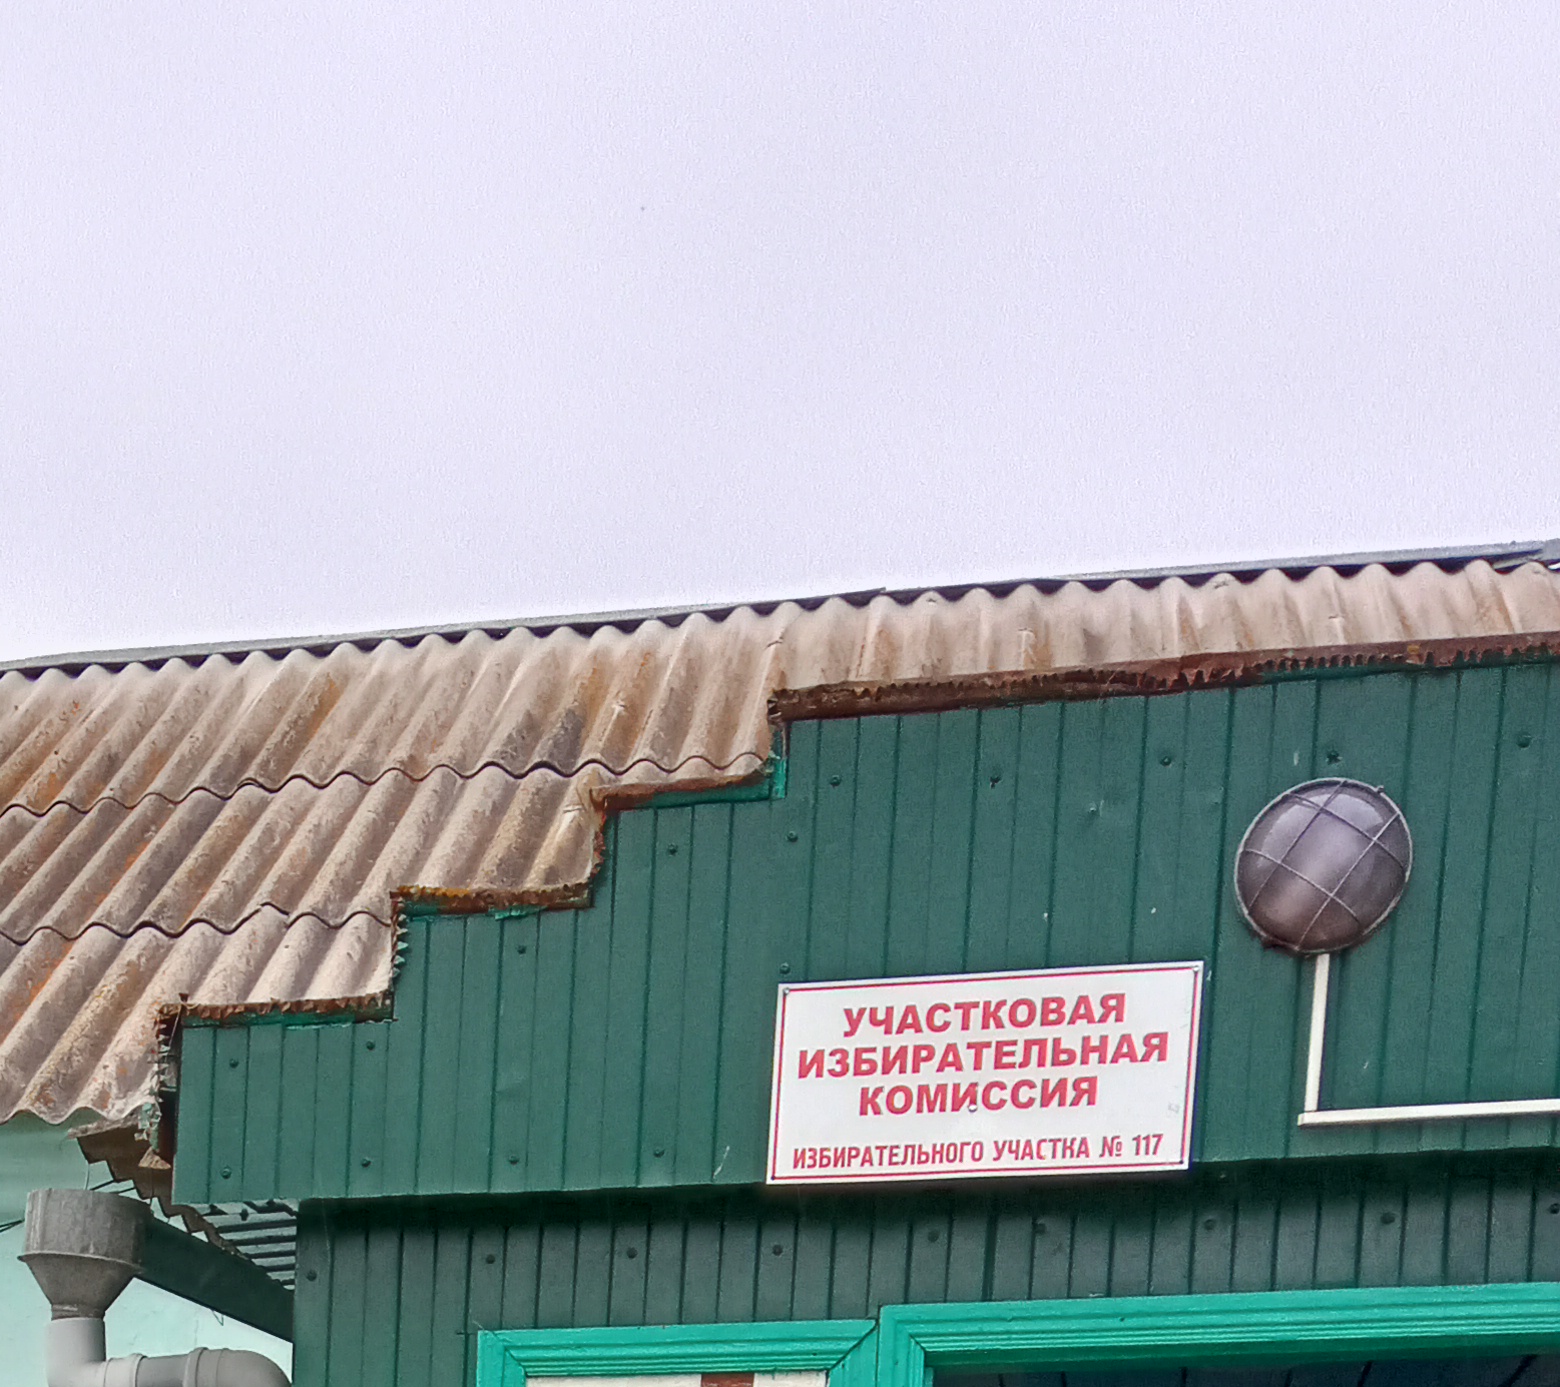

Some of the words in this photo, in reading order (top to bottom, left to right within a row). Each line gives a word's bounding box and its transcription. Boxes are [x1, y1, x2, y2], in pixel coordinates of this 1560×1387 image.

[843, 993, 1126, 1038] УЧАСТКОВАЯ
[798, 1032, 1169, 1079] ИЗБИРАТЕЛЬНАЯ
[859, 1076, 1098, 1116] КОМИССИЯ
[792, 1140, 984, 1170] ИЗБИРАТЕЛЬНОГО
[992, 1137, 1090, 1161] УЧАСТКА
[1099, 1135, 1122, 1158] №
[1132, 1134, 1164, 1157] 117
